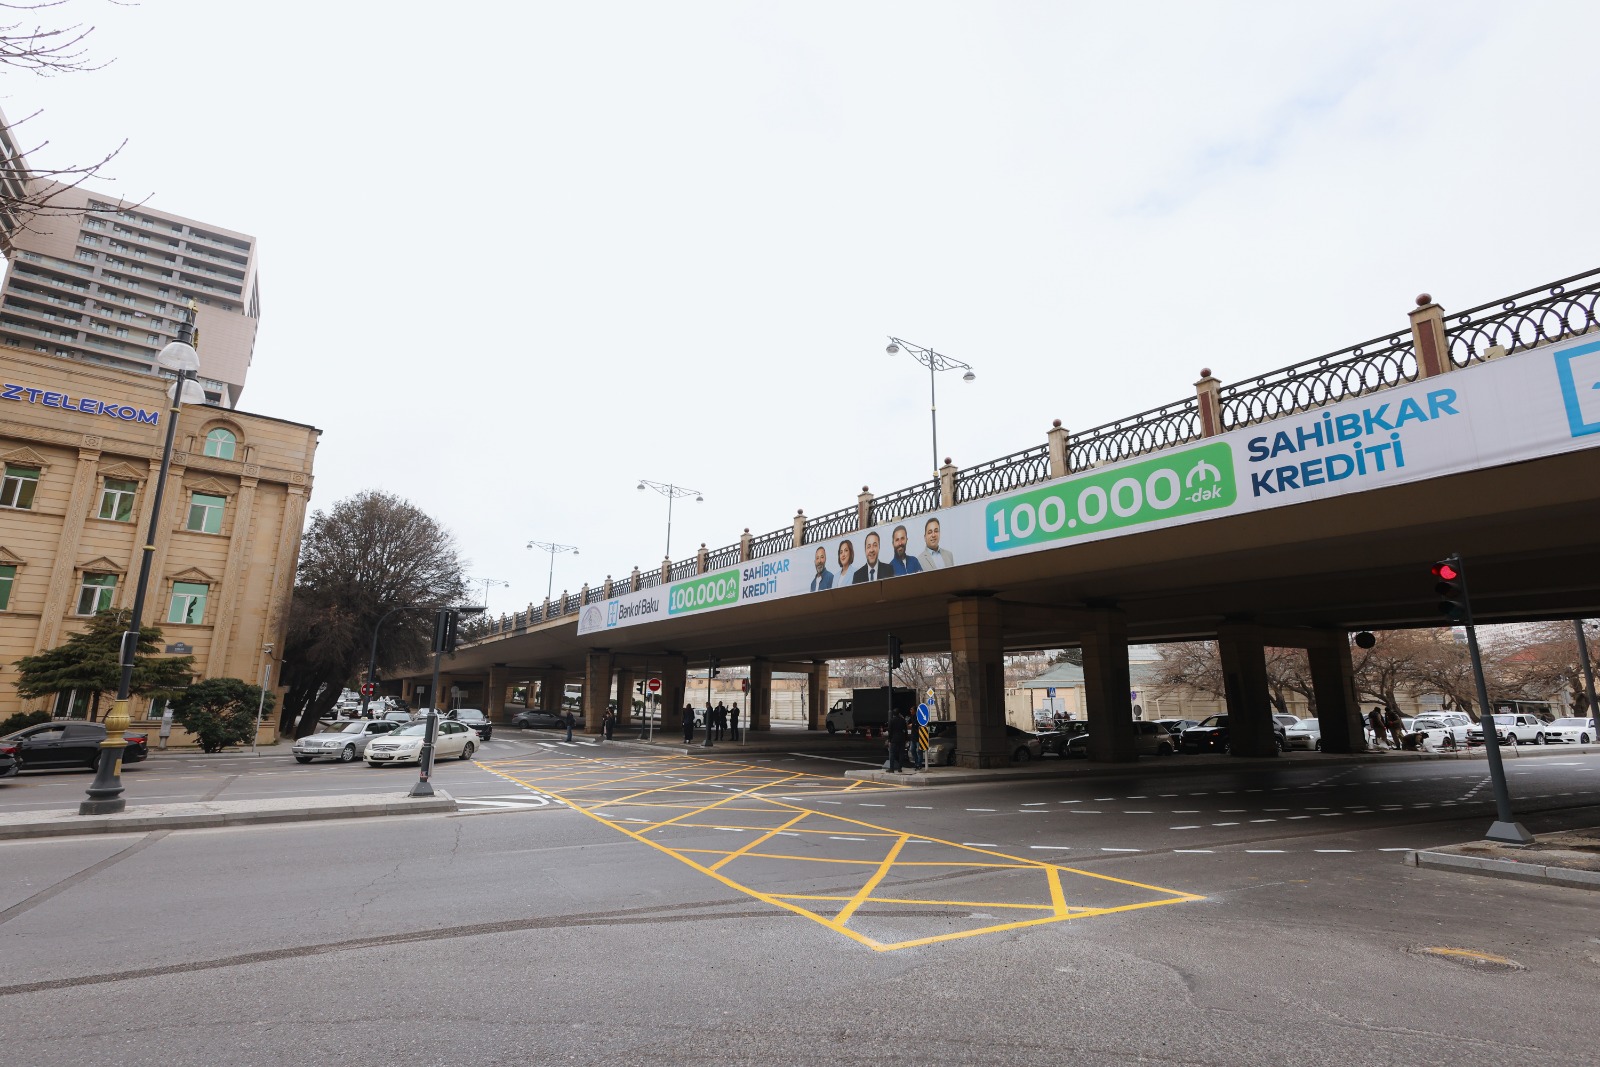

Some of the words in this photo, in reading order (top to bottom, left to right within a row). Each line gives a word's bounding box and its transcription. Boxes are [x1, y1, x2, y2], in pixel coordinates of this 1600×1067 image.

[0, 383, 159, 425] ZTELEKOM
[1247, 388, 1459, 462] SAHİBKAR
[1251, 432, 1405, 497] KREDİTİ
[743, 559, 790, 581] SAHİBKAR
[742, 576, 777, 599] KREDİTİ
[619, 602, 634, 619] Bank
[635, 600, 641, 616] of
[641, 597, 659, 615] Baku
